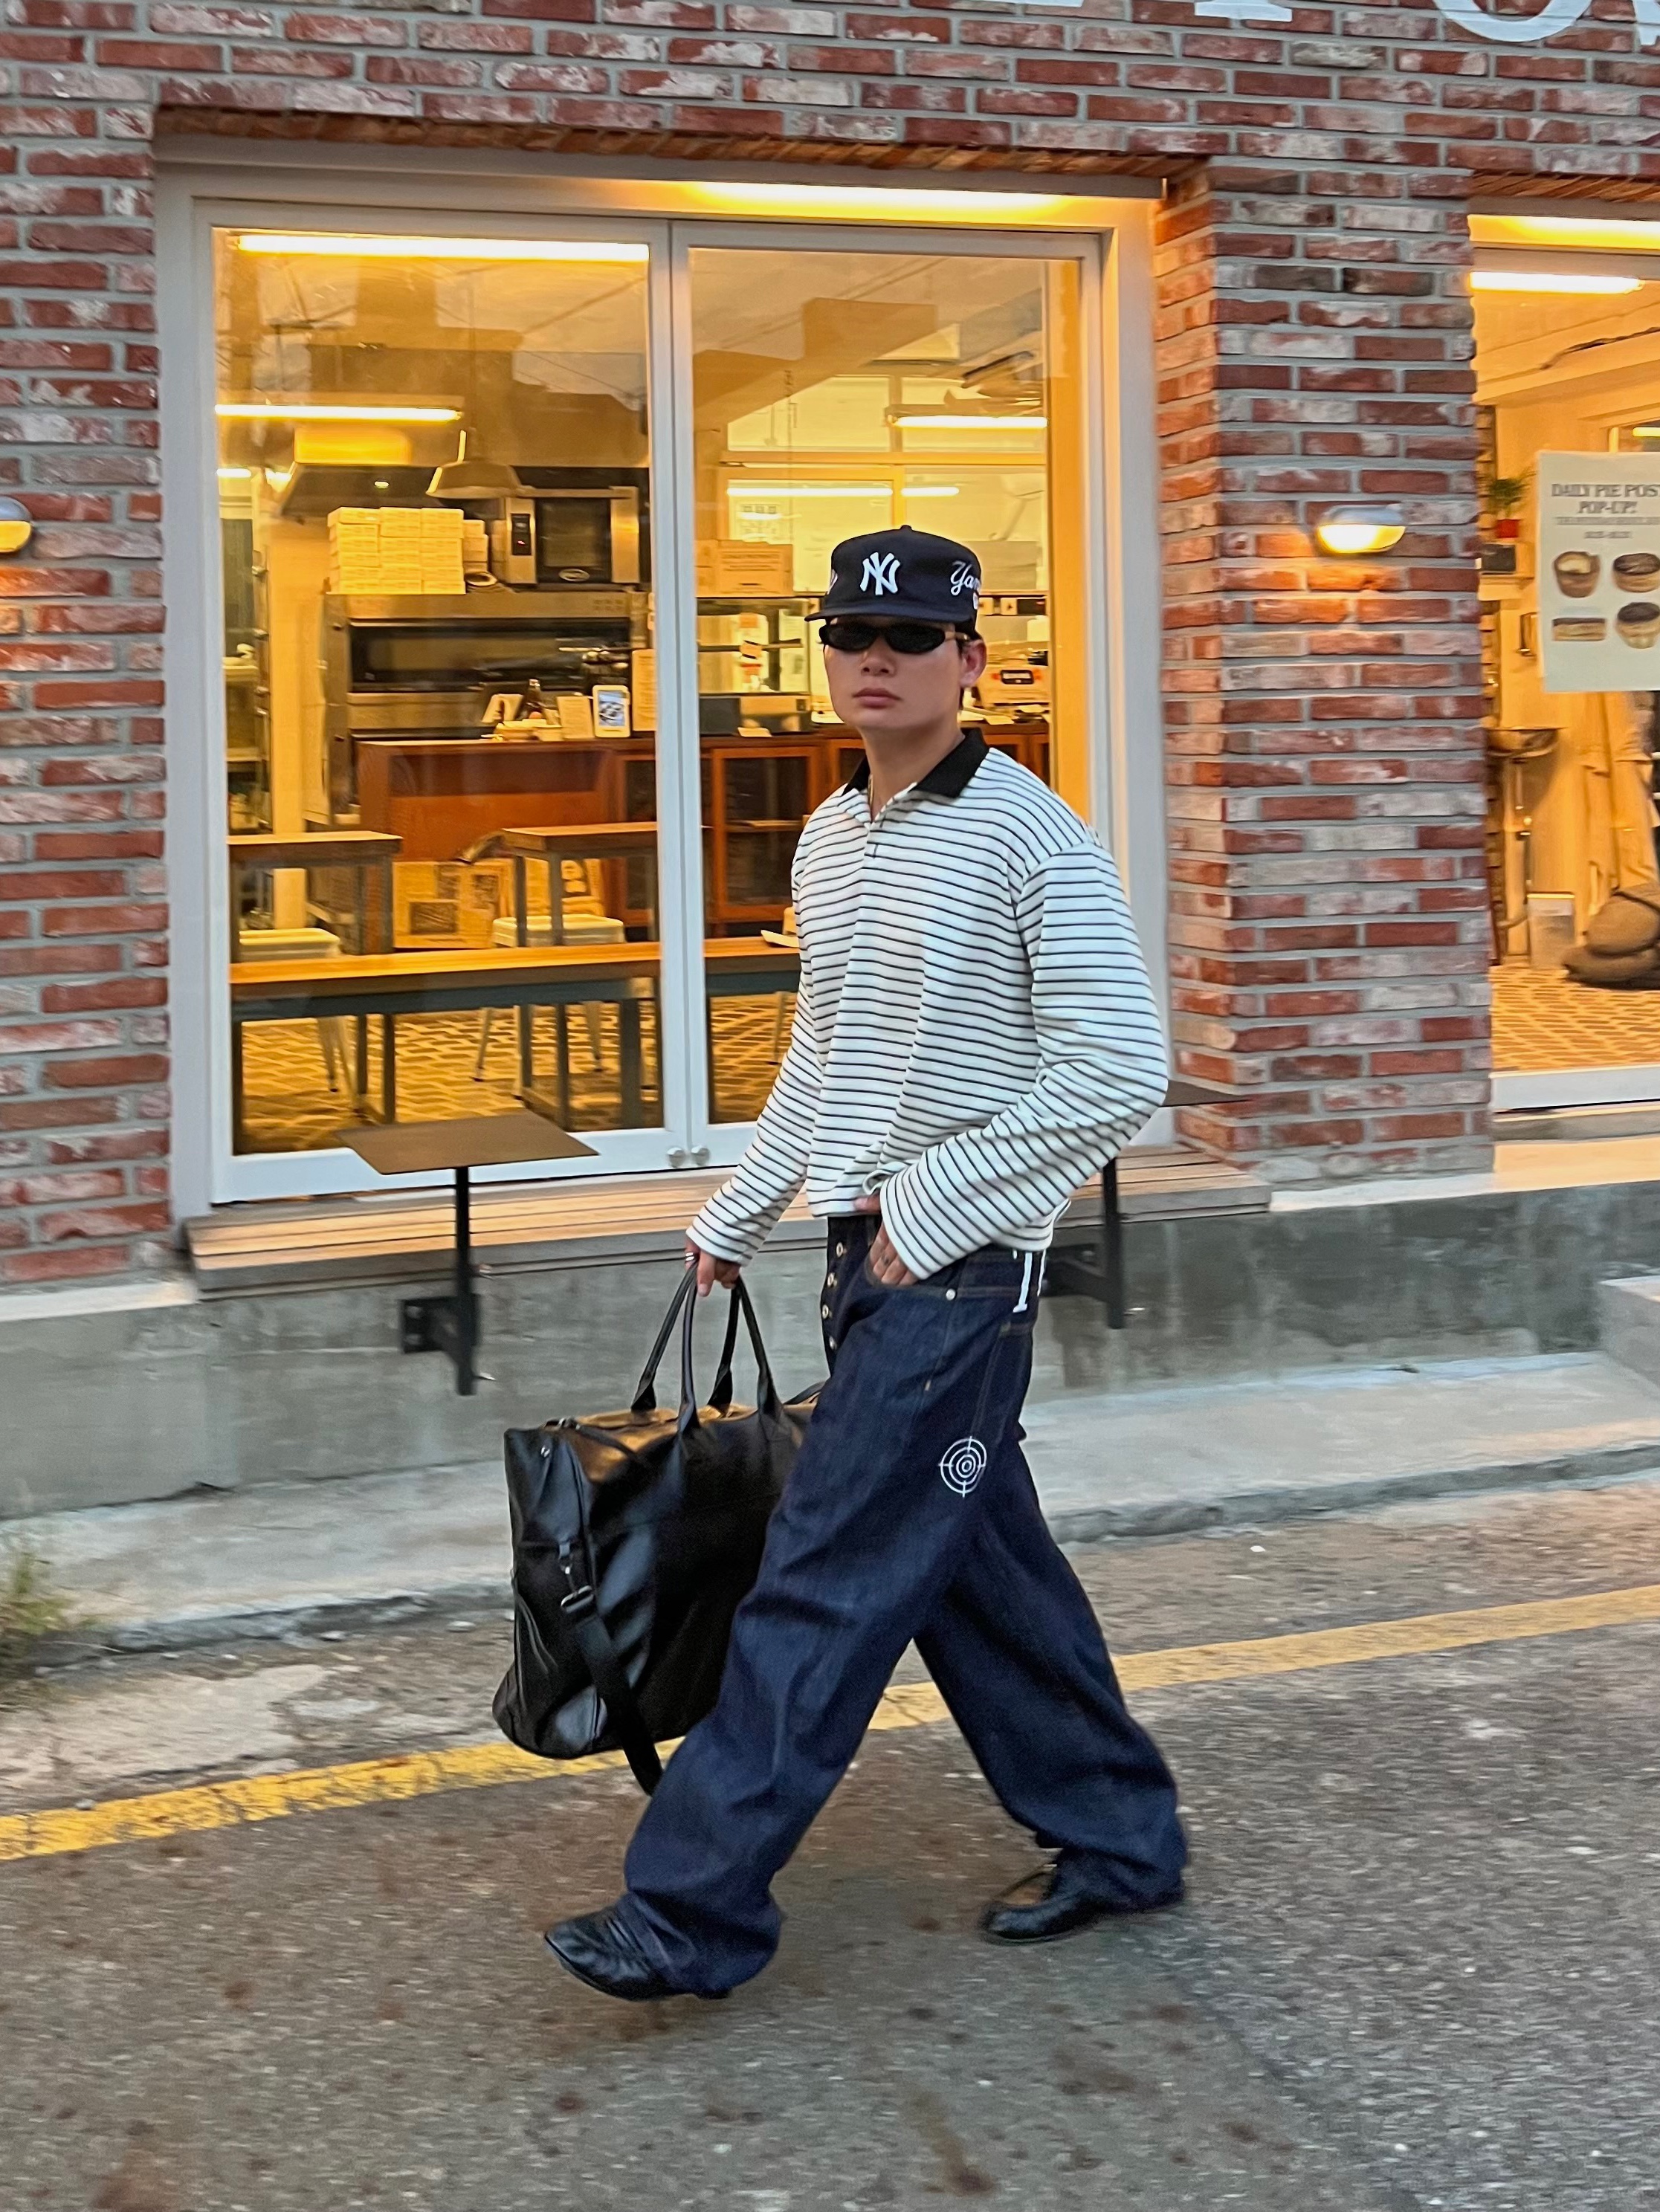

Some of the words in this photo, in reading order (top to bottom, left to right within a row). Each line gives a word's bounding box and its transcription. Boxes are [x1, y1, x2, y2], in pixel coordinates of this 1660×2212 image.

[1551, 484, 1590, 497] DAILY
[1595, 485, 1621, 497] PIE
[1625, 484, 1660, 497] POS
[860, 552, 900, 595] NY
